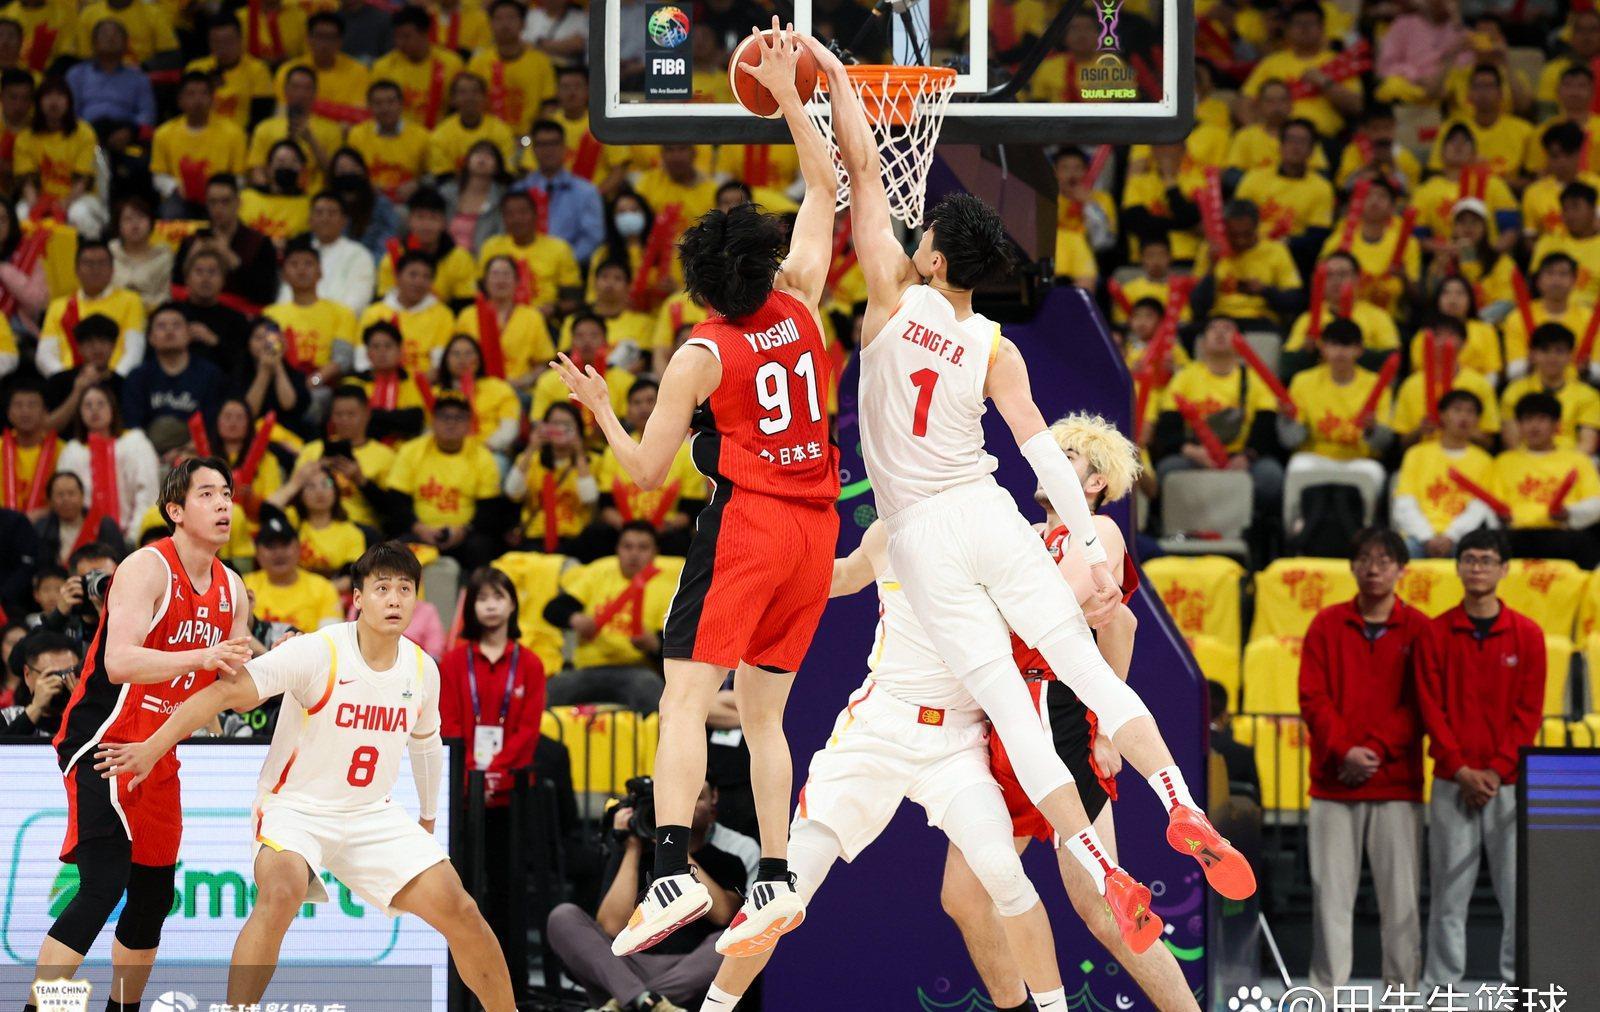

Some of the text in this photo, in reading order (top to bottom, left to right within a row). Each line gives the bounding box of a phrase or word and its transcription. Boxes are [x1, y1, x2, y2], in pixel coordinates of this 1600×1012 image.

[652, 58, 685, 75] FIBA
[1081, 67, 1108, 81] ASIA
[1080, 88, 1136, 98] QUALIFIERS
[744, 317, 800, 353] YOSHII
[902, 320, 942, 352] ZENG
[755, 350, 822, 435] 91
[909, 368, 939, 437] 1
[168, 620, 223, 648] JAPAN
[335, 703, 407, 732] CHINA
[347, 746, 379, 787] 8
